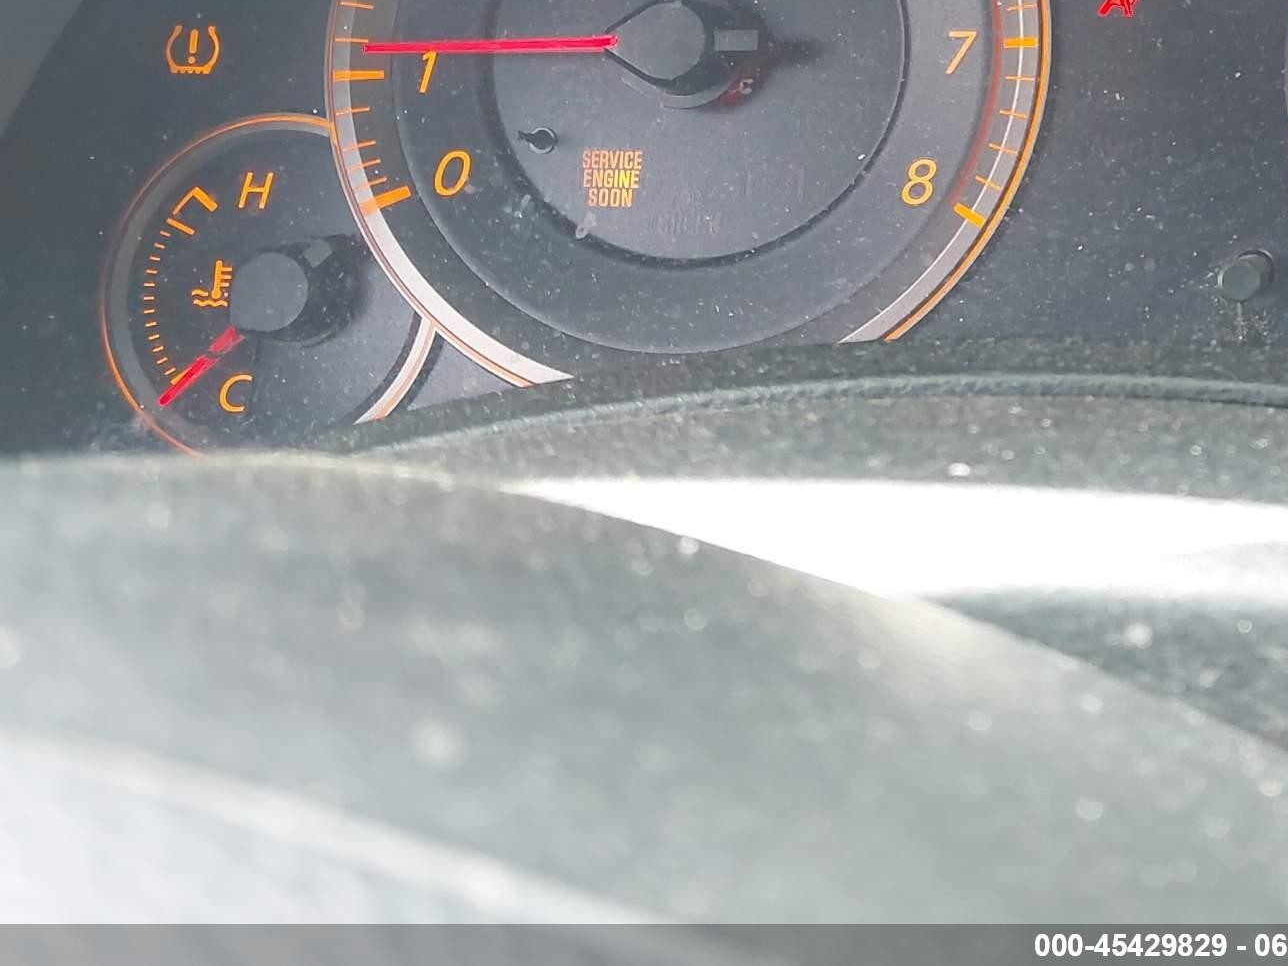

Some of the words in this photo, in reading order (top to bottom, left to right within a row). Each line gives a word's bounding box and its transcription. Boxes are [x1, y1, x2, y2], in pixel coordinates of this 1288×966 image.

[419, 49, 437, 93] 1
[946, 30, 976, 75] 7
[434, 150, 471, 196] 0
[582, 149, 644, 170] SERVICE
[583, 169, 640, 189] ENGINE
[237, 172, 274, 209] H
[587, 188, 633, 209] SOON
[900, 159, 937, 206] 8
[218, 373, 254, 413] C
